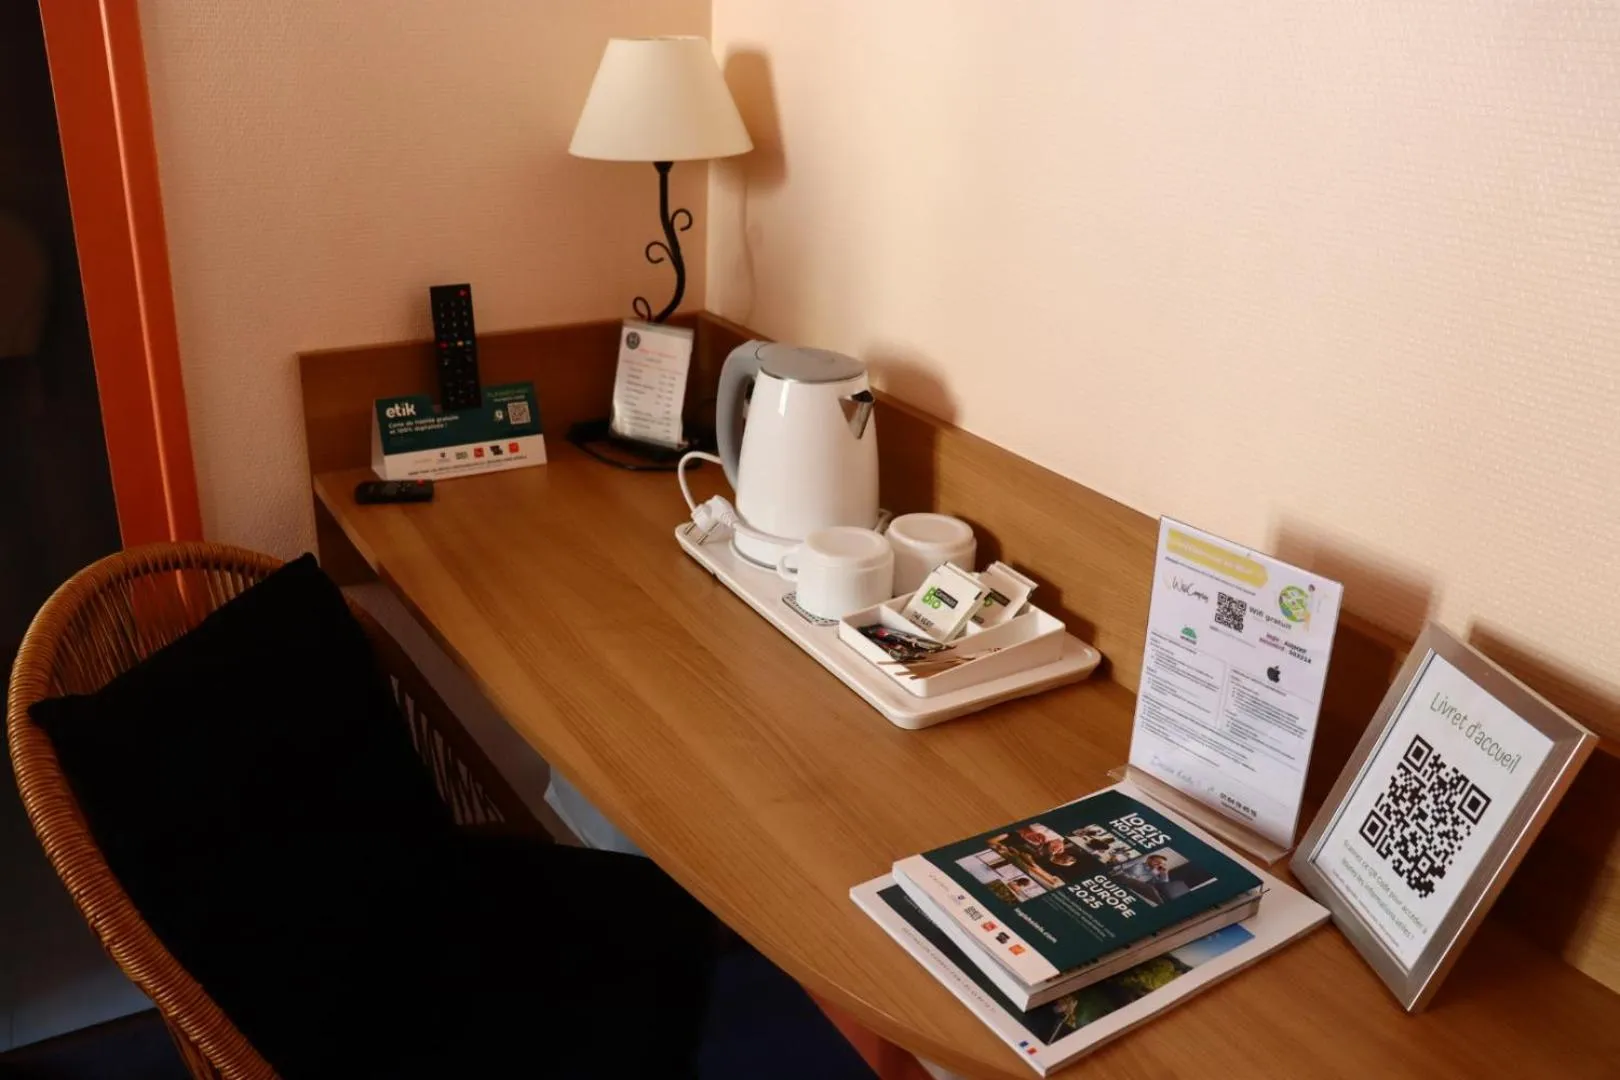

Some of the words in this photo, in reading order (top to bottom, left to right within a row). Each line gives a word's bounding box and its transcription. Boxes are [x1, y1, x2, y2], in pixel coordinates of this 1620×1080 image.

[386, 402, 416, 418] etik
[1430, 692, 1468, 730] Livret
[1465, 721, 1522, 774] d'accueil
[1109, 819, 1157, 849] HOTELS
[1068, 884, 1103, 909] 2025
[1081, 879, 1136, 918] EUROPE
[1094, 875, 1136, 905] GUIDE
